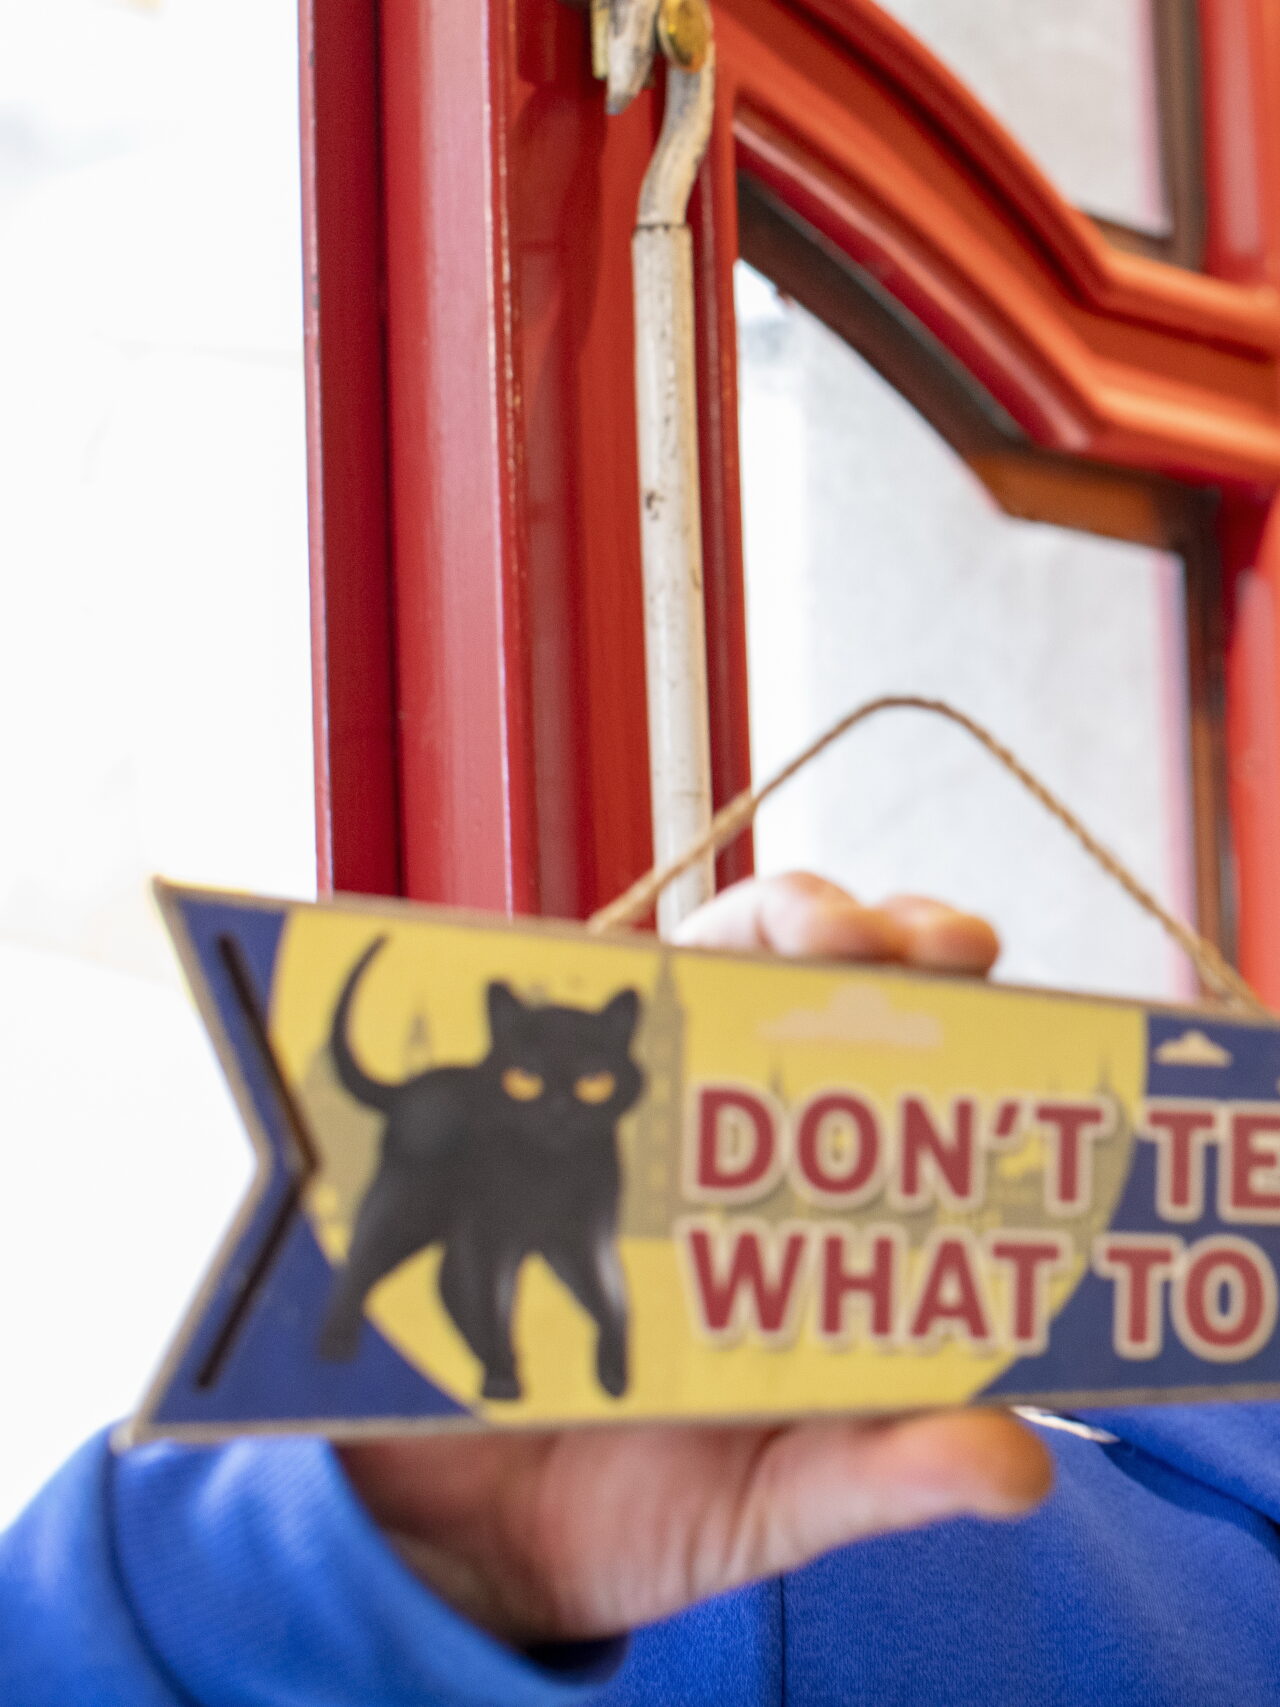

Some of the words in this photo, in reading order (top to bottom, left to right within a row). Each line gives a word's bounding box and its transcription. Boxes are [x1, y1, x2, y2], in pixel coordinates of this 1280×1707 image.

[694, 1086, 1106, 1206] DON'T
[687, 1228, 1062, 1345] WHAT
[1104, 1244, 1268, 1350] TO
